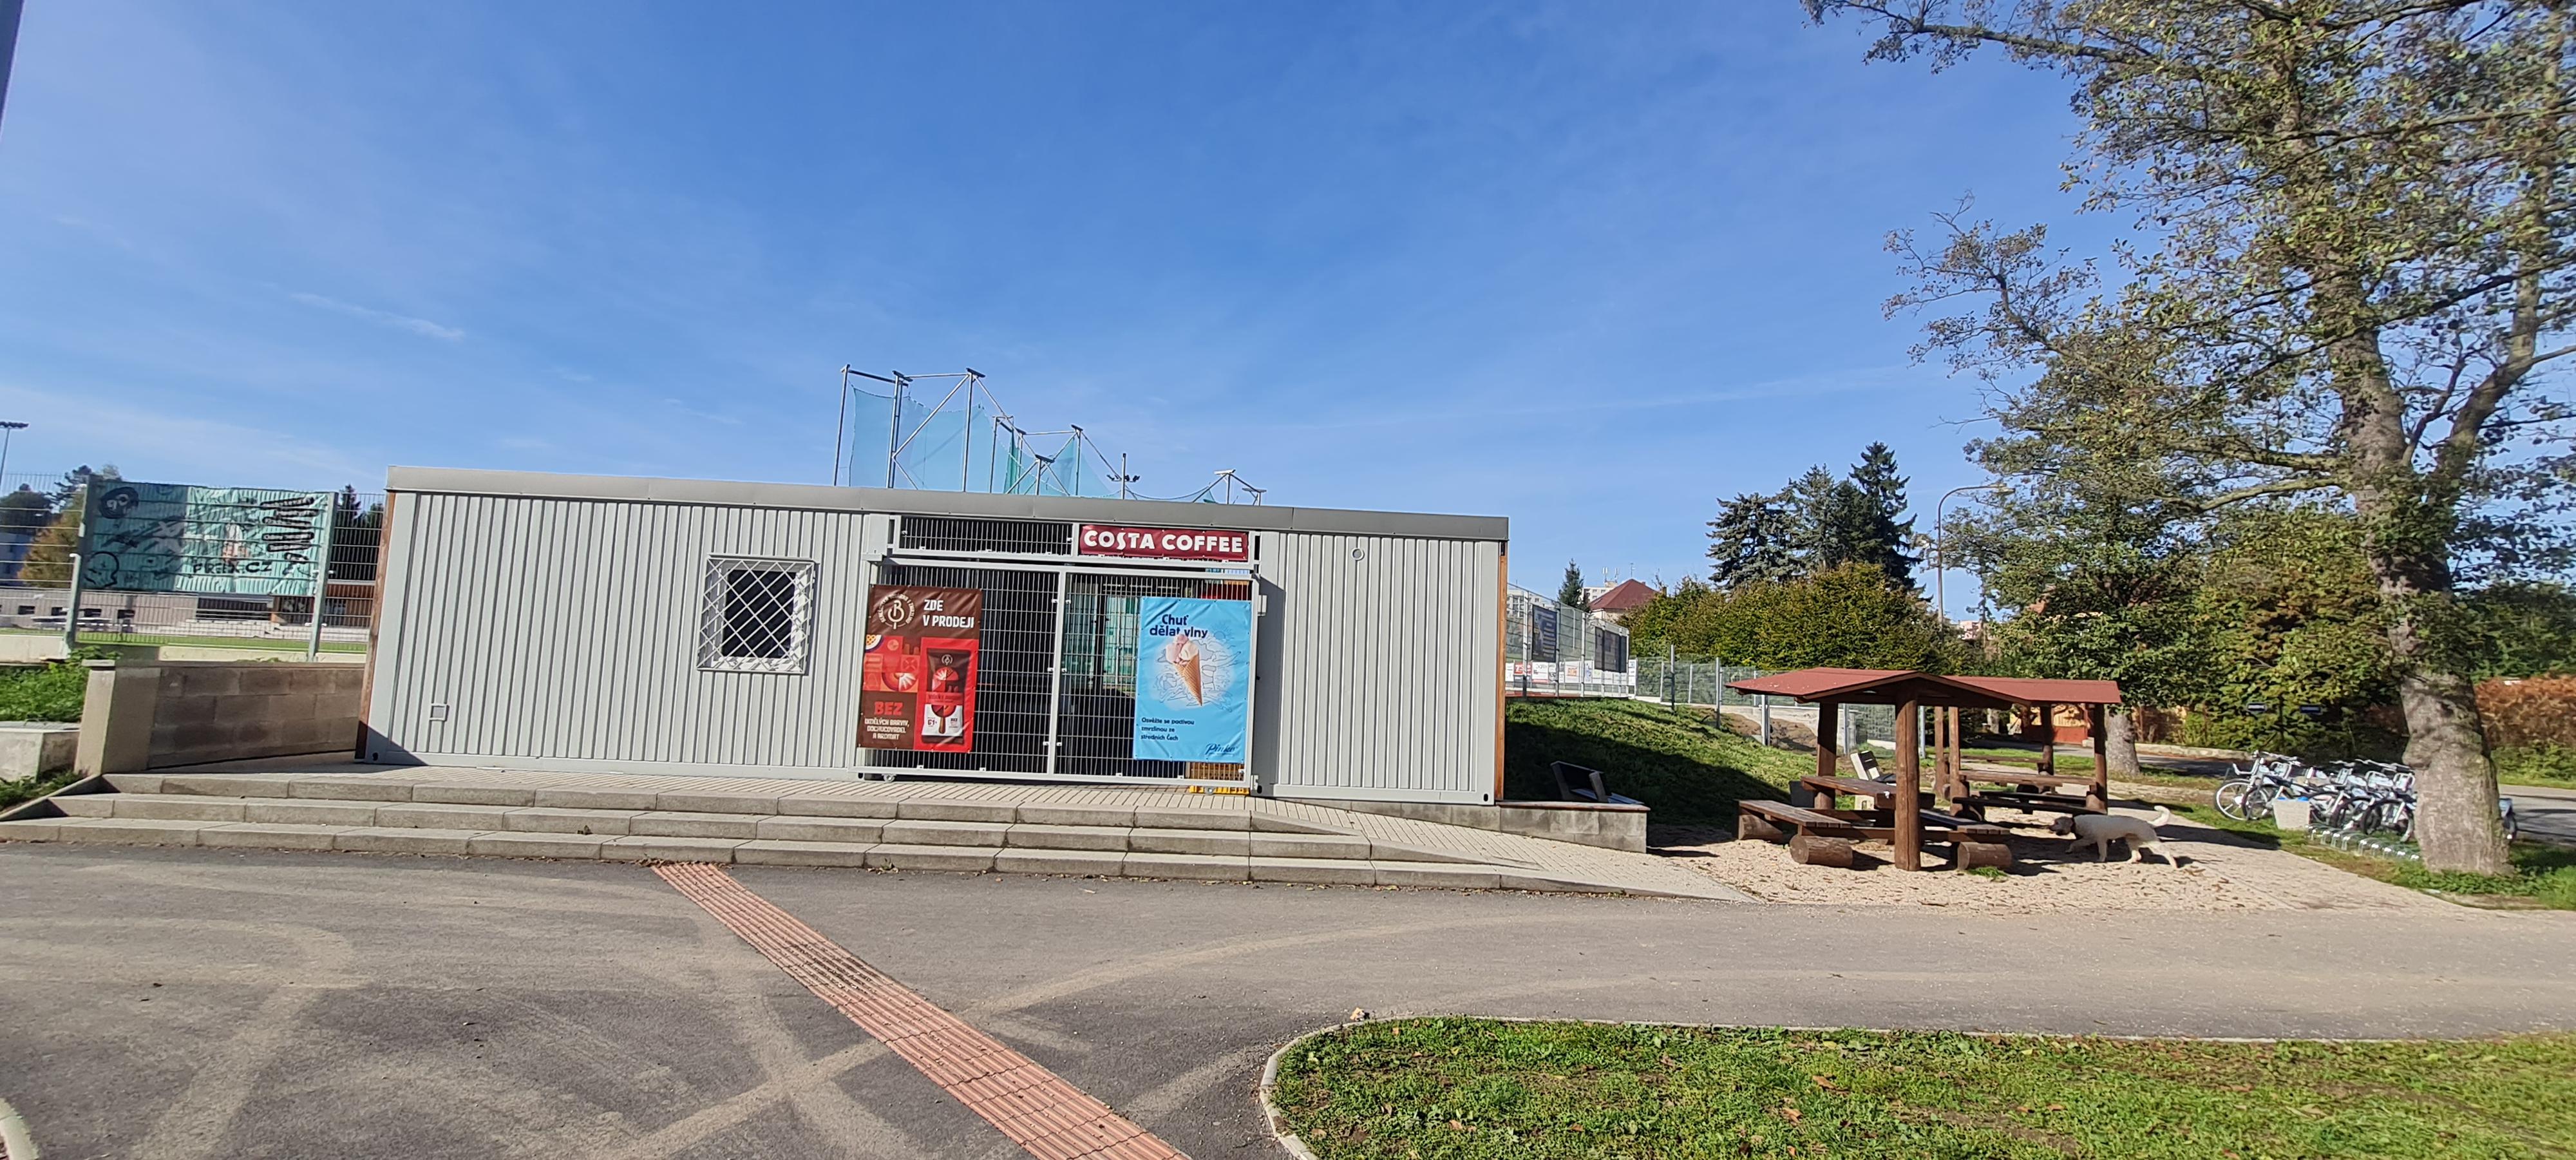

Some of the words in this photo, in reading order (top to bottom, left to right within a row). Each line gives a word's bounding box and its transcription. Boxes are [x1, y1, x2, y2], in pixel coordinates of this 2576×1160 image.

[1083, 529, 1155, 551] COSTA
[1161, 533, 1243, 553] COFFEE
[923, 599, 944, 611] ZDE
[922, 614, 930, 626] V
[932, 615, 974, 628] PRODEJI
[1161, 614, 1189, 626] Chuť
[1184, 626, 1209, 639] vlny
[874, 701, 903, 716] BEZ
